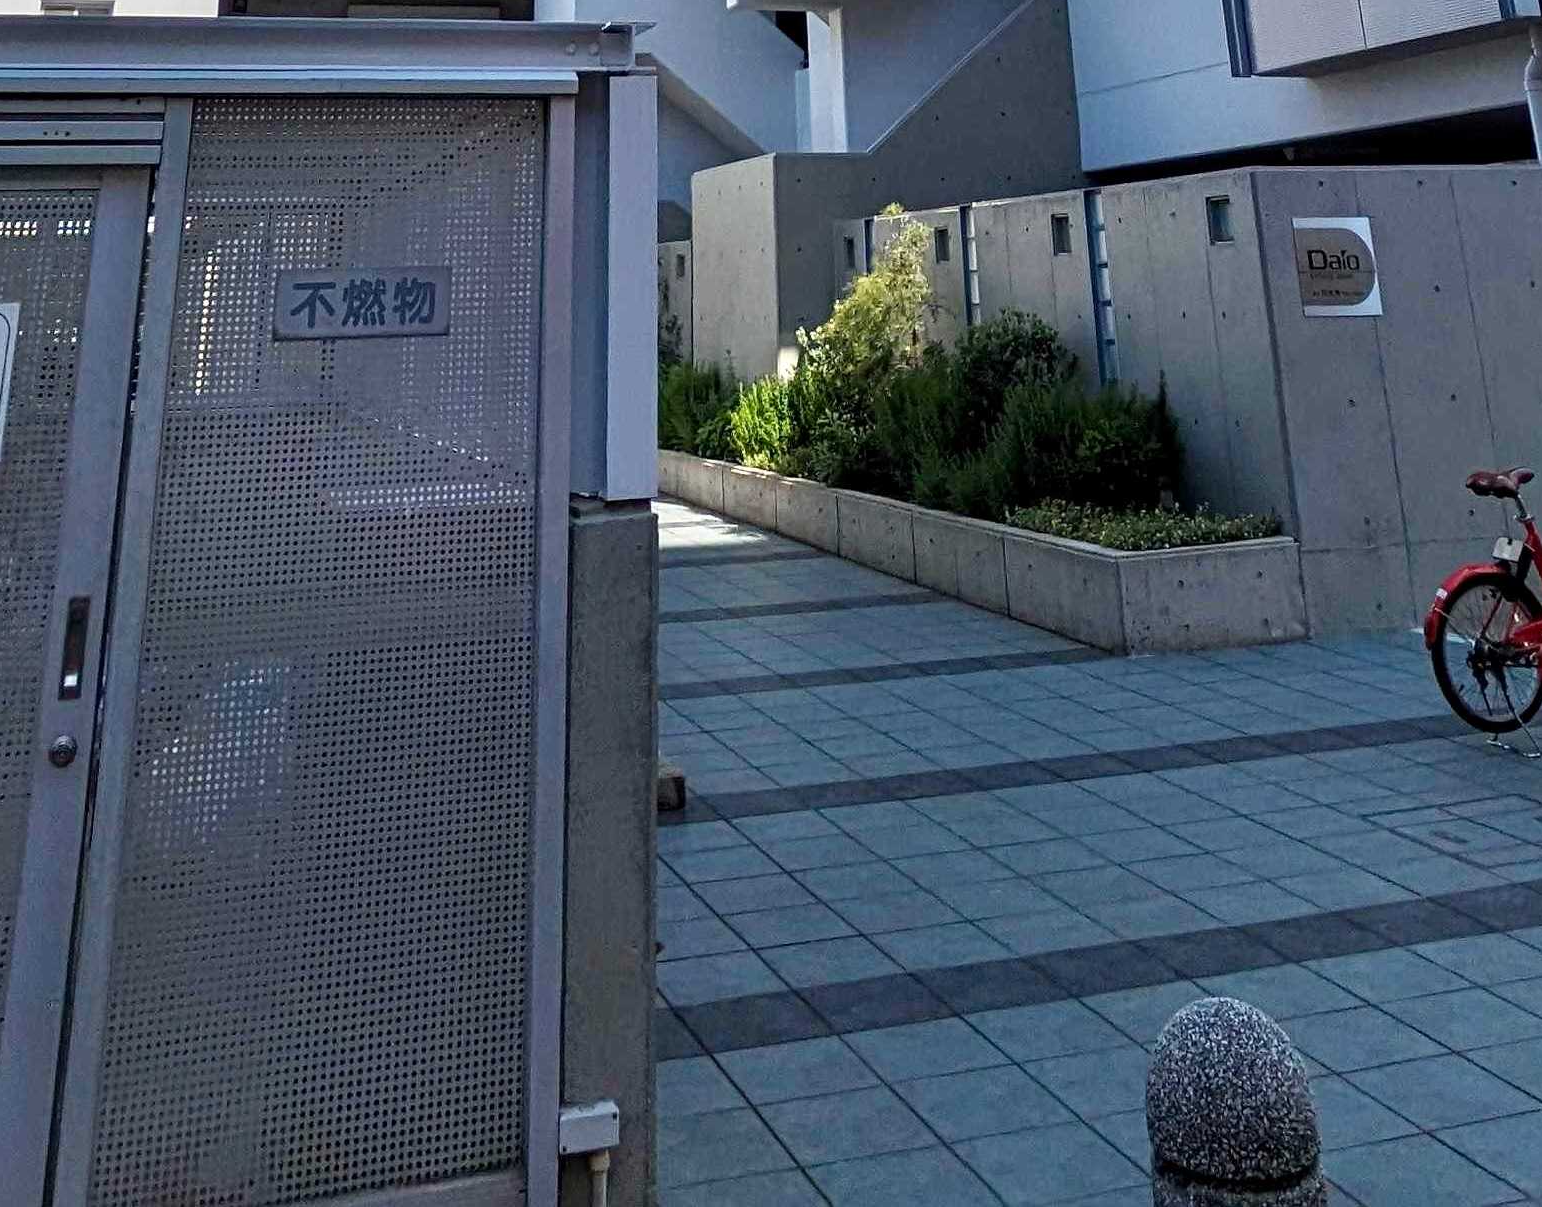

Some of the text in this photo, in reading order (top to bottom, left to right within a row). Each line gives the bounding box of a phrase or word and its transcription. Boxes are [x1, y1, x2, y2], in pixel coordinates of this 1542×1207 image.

[1307, 249, 1360, 270] Daio
[290, 277, 436, 329] 不燃物
